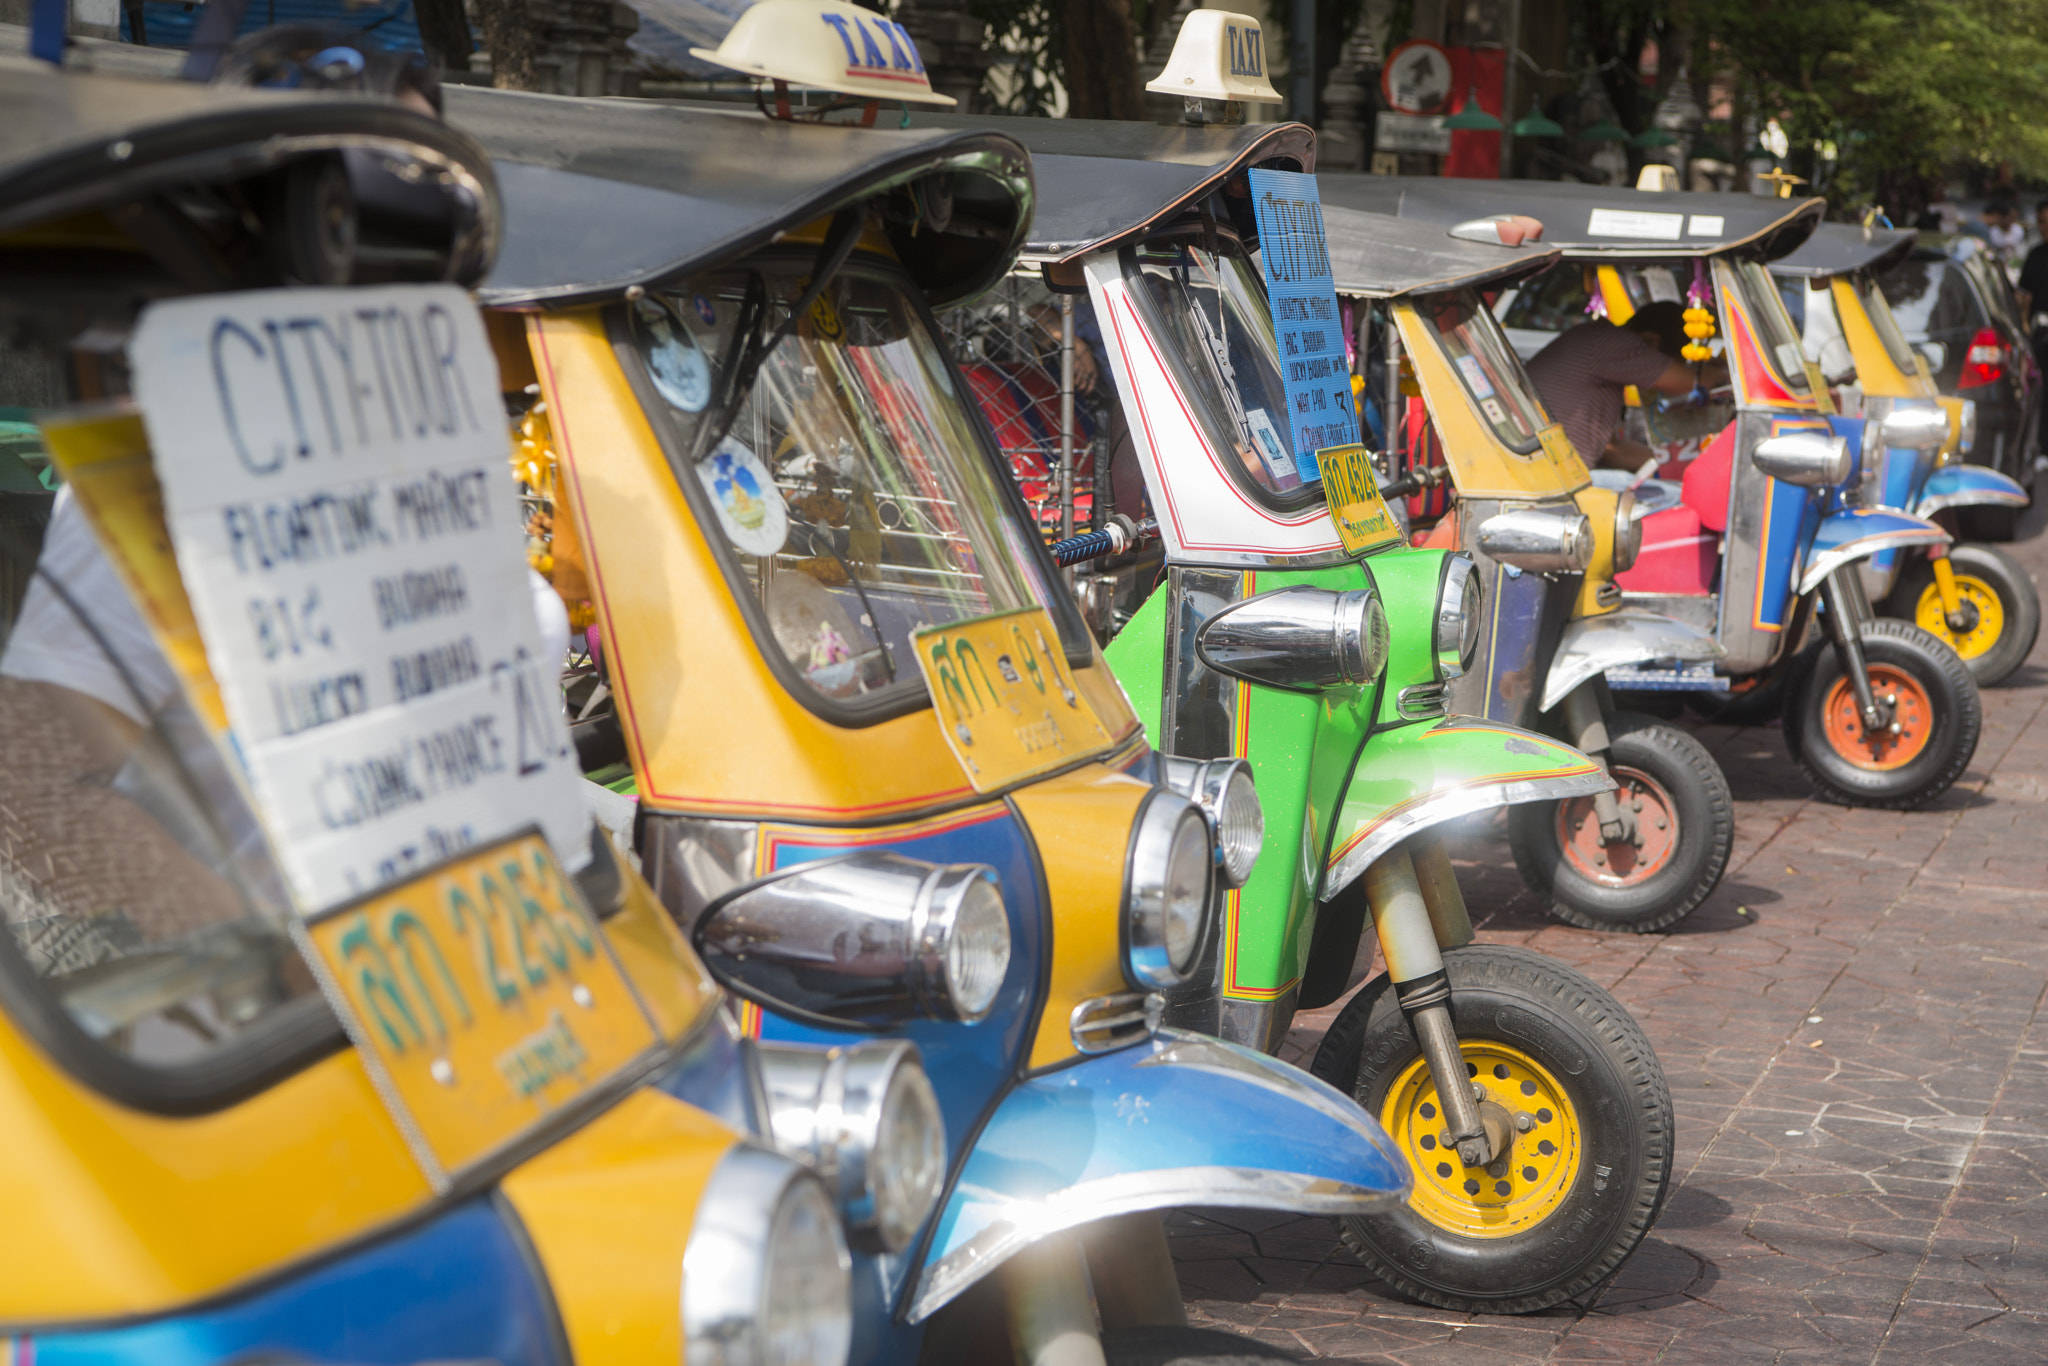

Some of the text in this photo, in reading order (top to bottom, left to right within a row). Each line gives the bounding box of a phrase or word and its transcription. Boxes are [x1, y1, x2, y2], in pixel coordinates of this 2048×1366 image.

[821, 13, 925, 75] TAXI
[1226, 25, 1262, 77] TAXI
[1283, 330, 1300, 356] BIG
[1294, 388, 1327, 414] WAT PHO
[1343, 451, 1377, 504] 4529
[247, 585, 336, 662] BIG
[440, 842, 597, 1006] 2253
